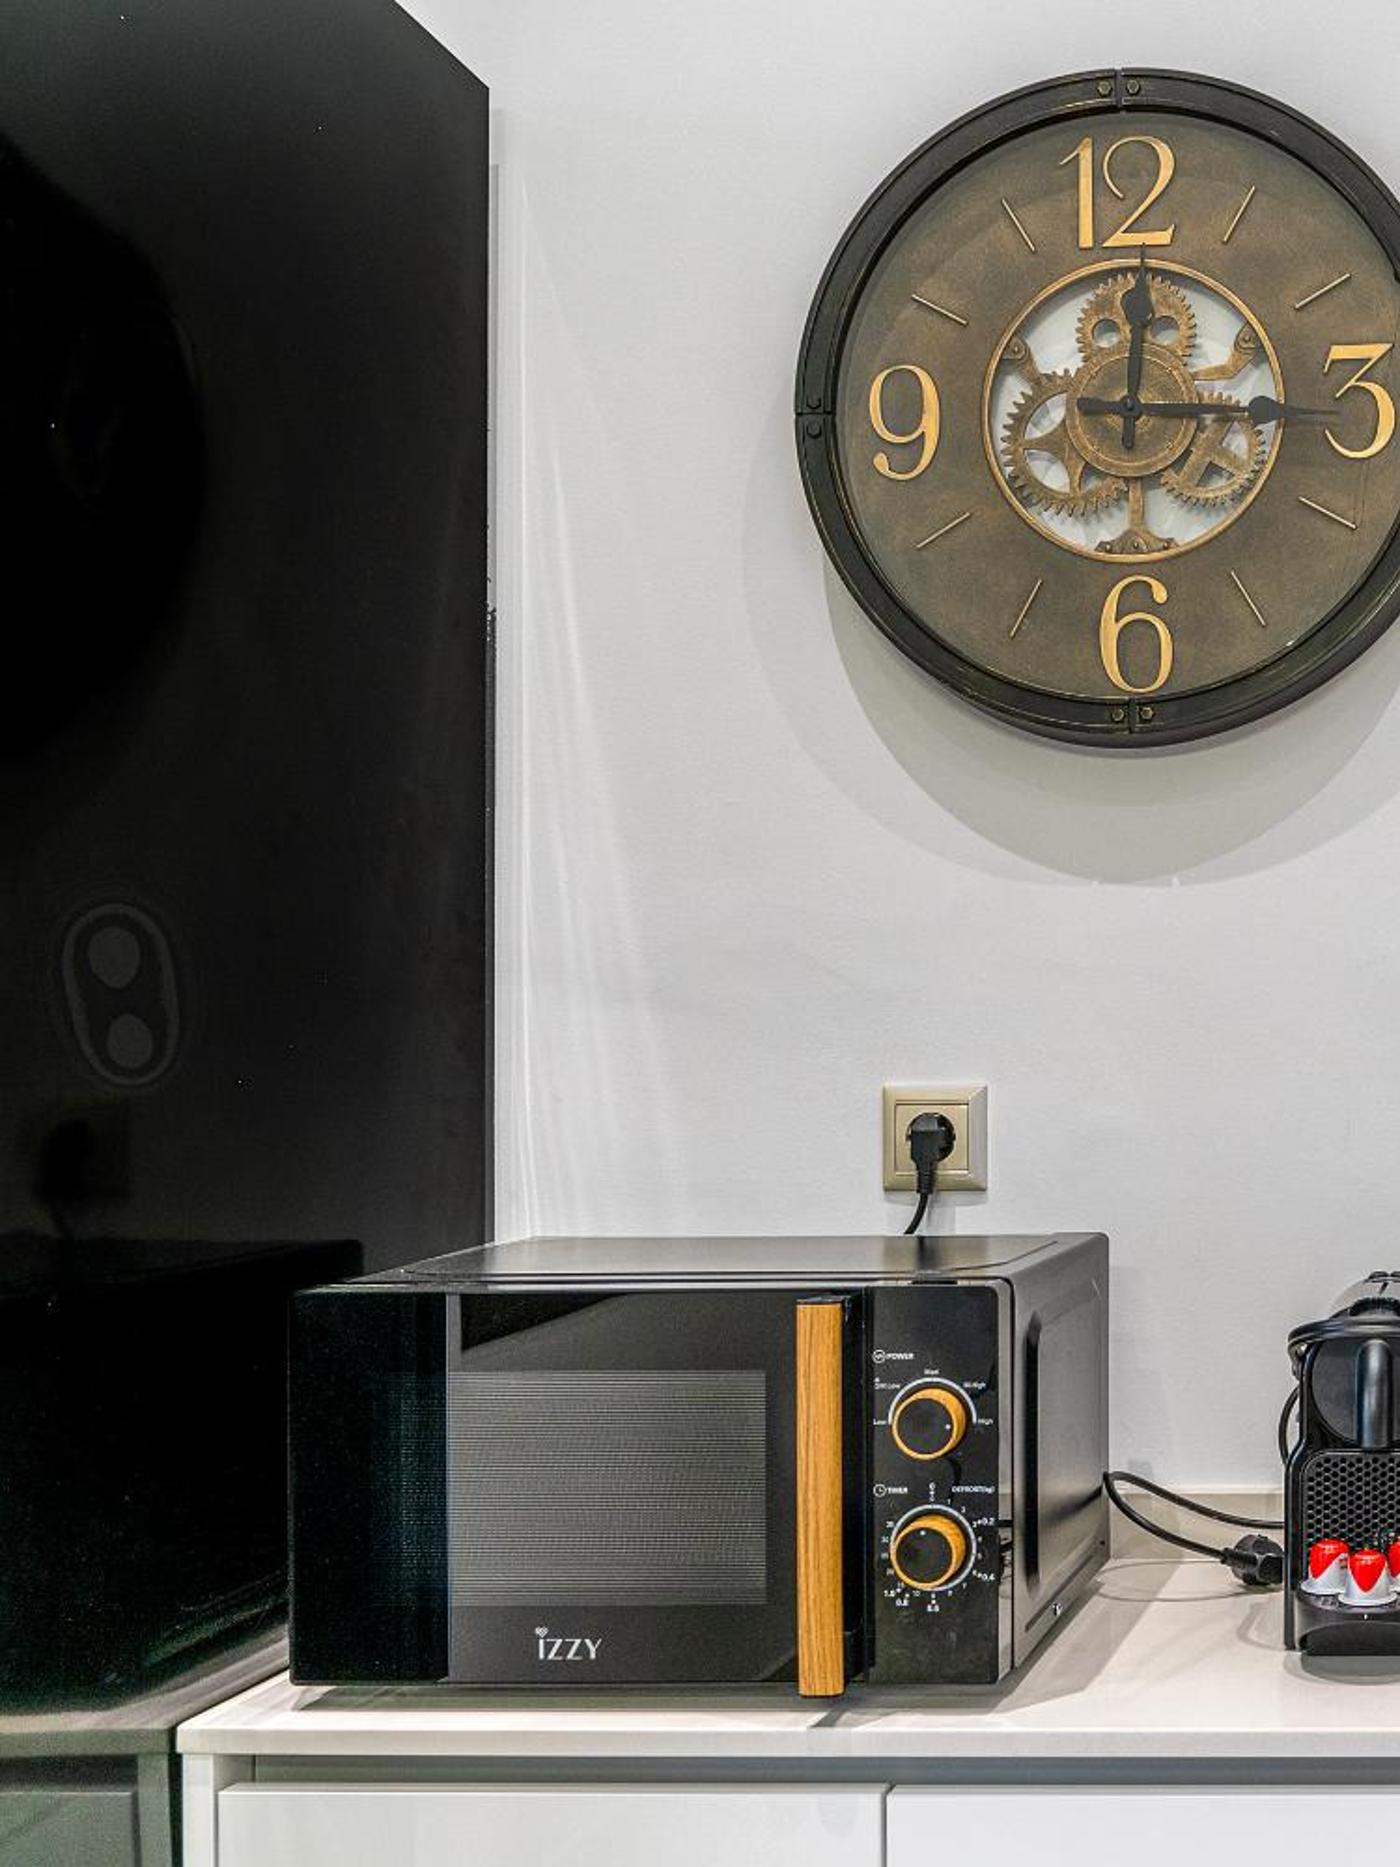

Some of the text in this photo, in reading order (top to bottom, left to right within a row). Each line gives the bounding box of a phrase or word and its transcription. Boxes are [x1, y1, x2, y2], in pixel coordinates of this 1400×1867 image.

[1058, 134, 1176, 249] 12
[868, 364, 941, 481] 9
[1322, 342, 1397, 459] 3
[1099, 573, 1175, 693] 6
